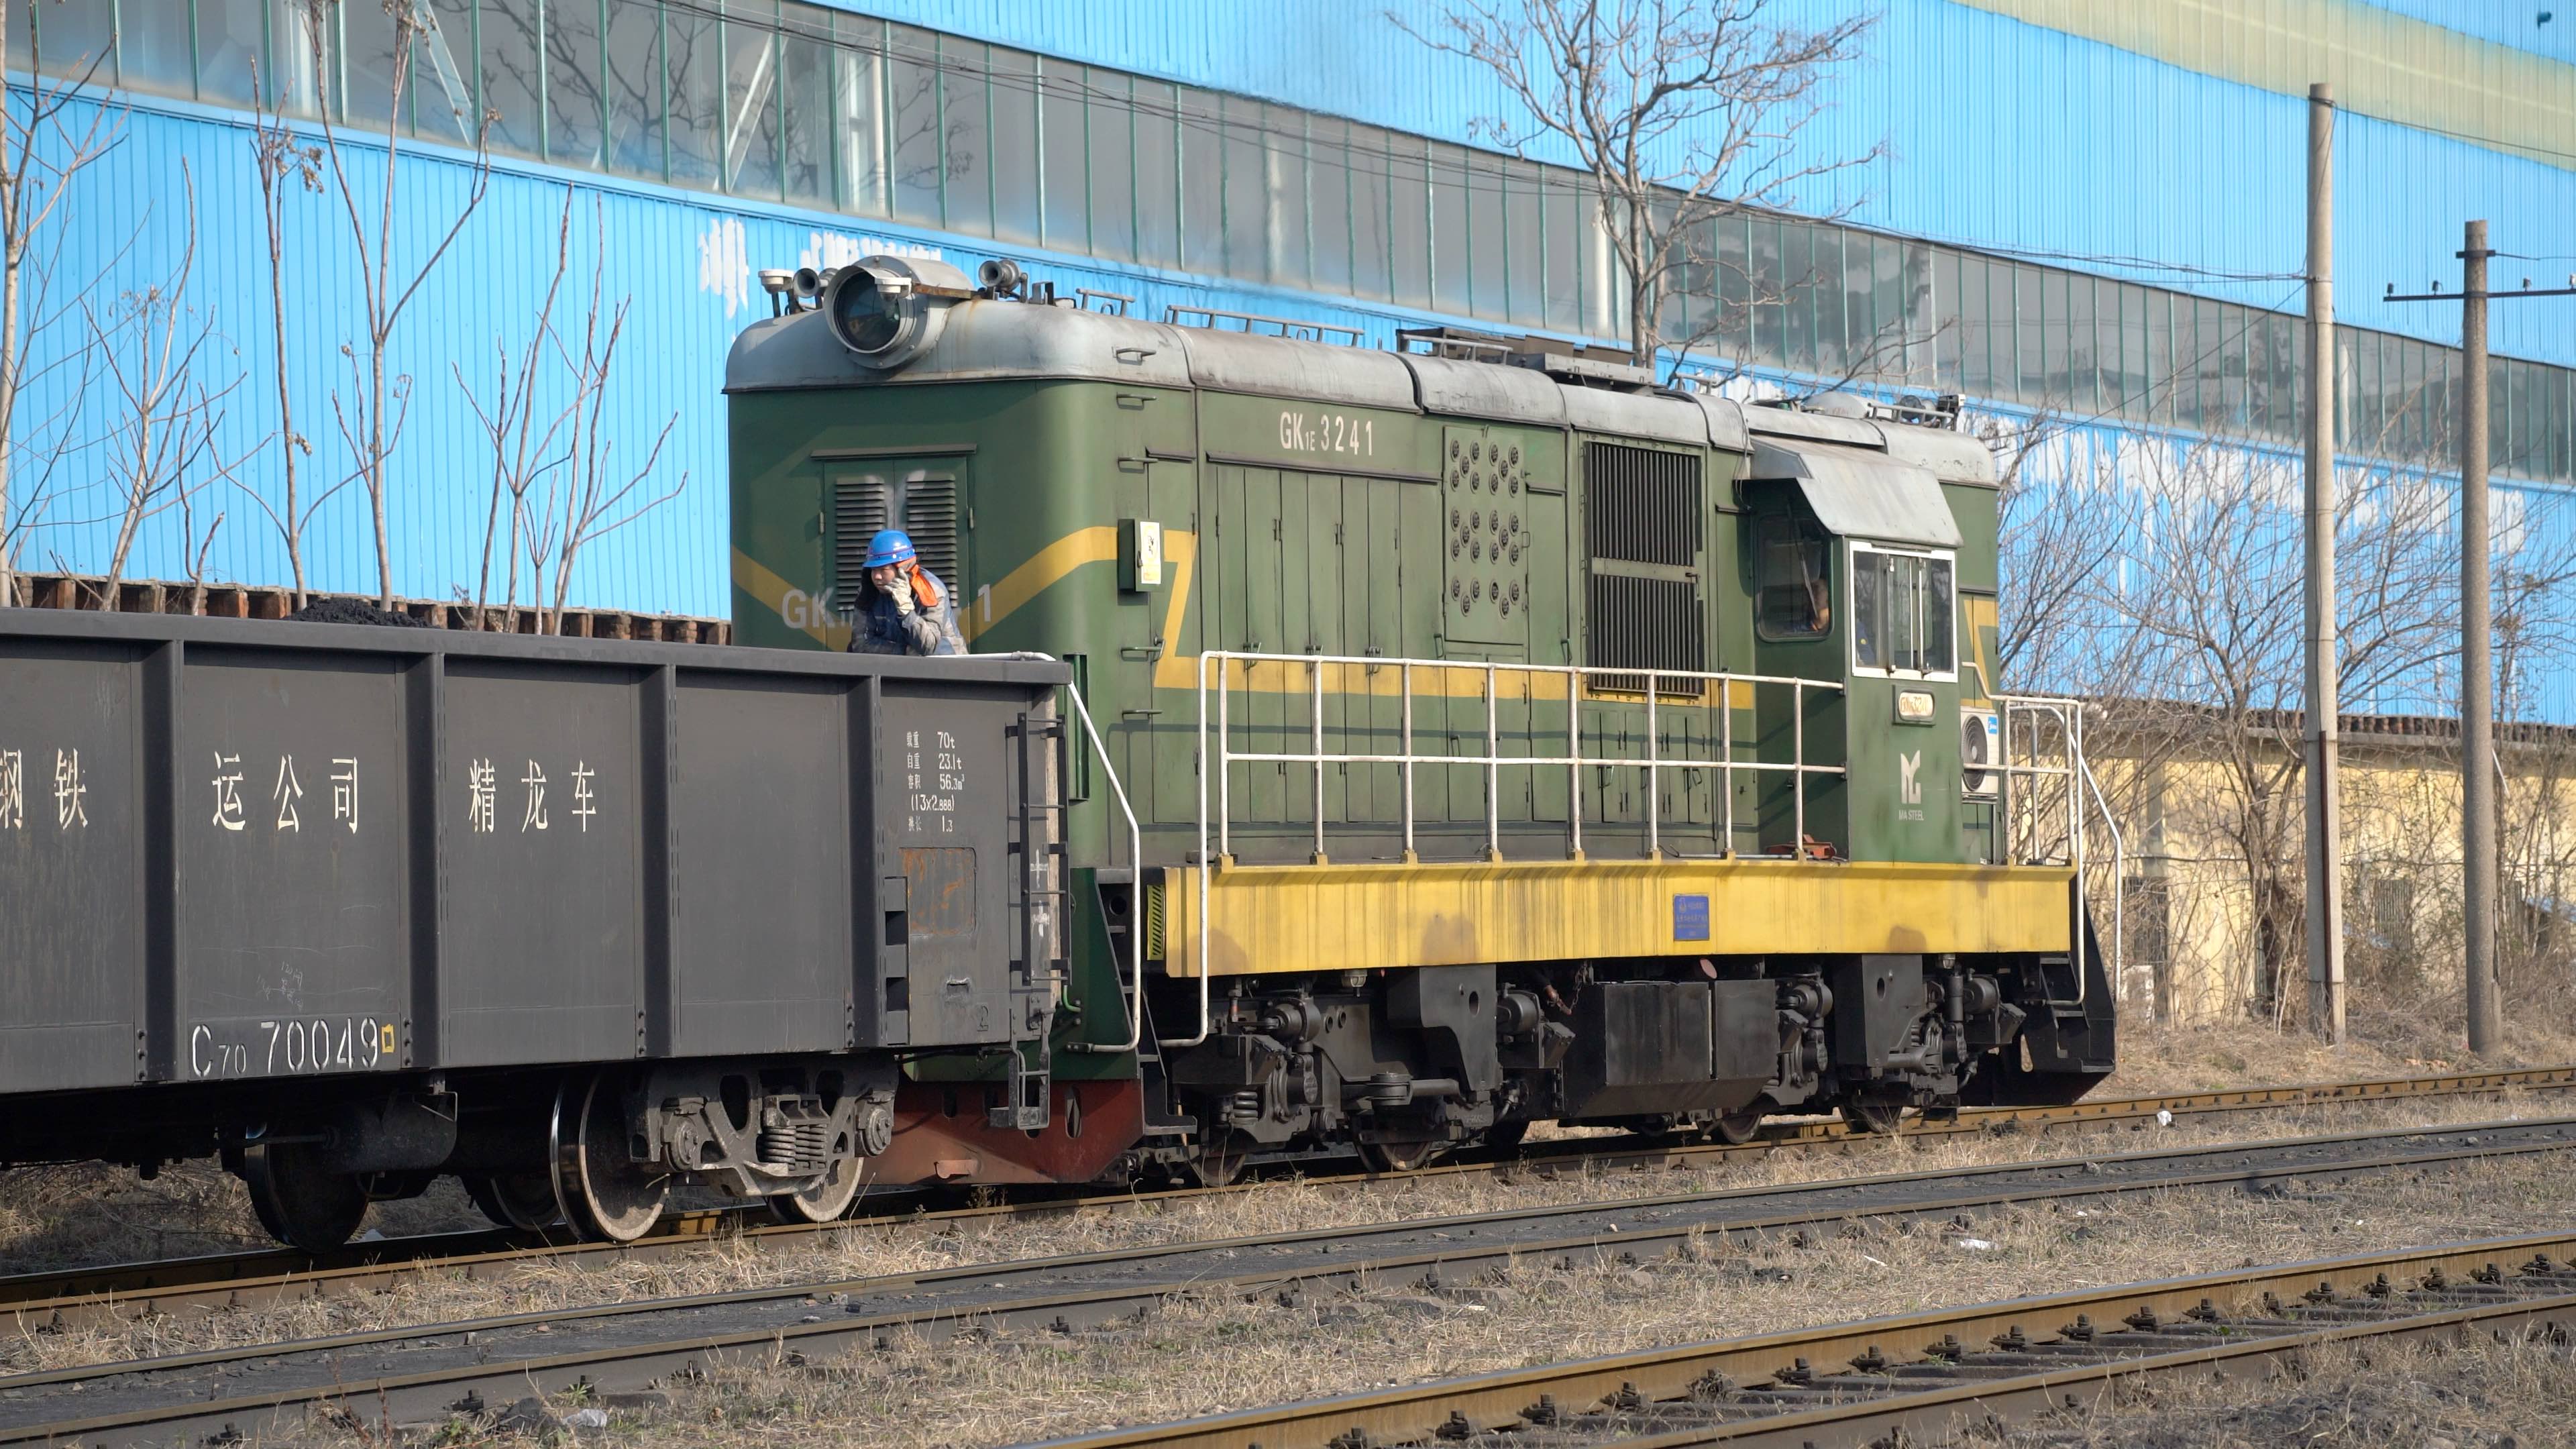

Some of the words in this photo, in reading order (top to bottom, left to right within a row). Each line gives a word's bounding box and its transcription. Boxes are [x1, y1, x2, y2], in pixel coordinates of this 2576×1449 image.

[1320, 414, 1372, 455] 3241
[937, 731, 955, 749] 70t
[907, 752, 920, 769] 自重
[908, 773, 921, 790] 容积
[212, 751, 358, 834] 运公司
[469, 757, 596, 833] 精龙车
[942, 815, 953, 833] 1.3
[261, 1017, 378, 1074] 70049
